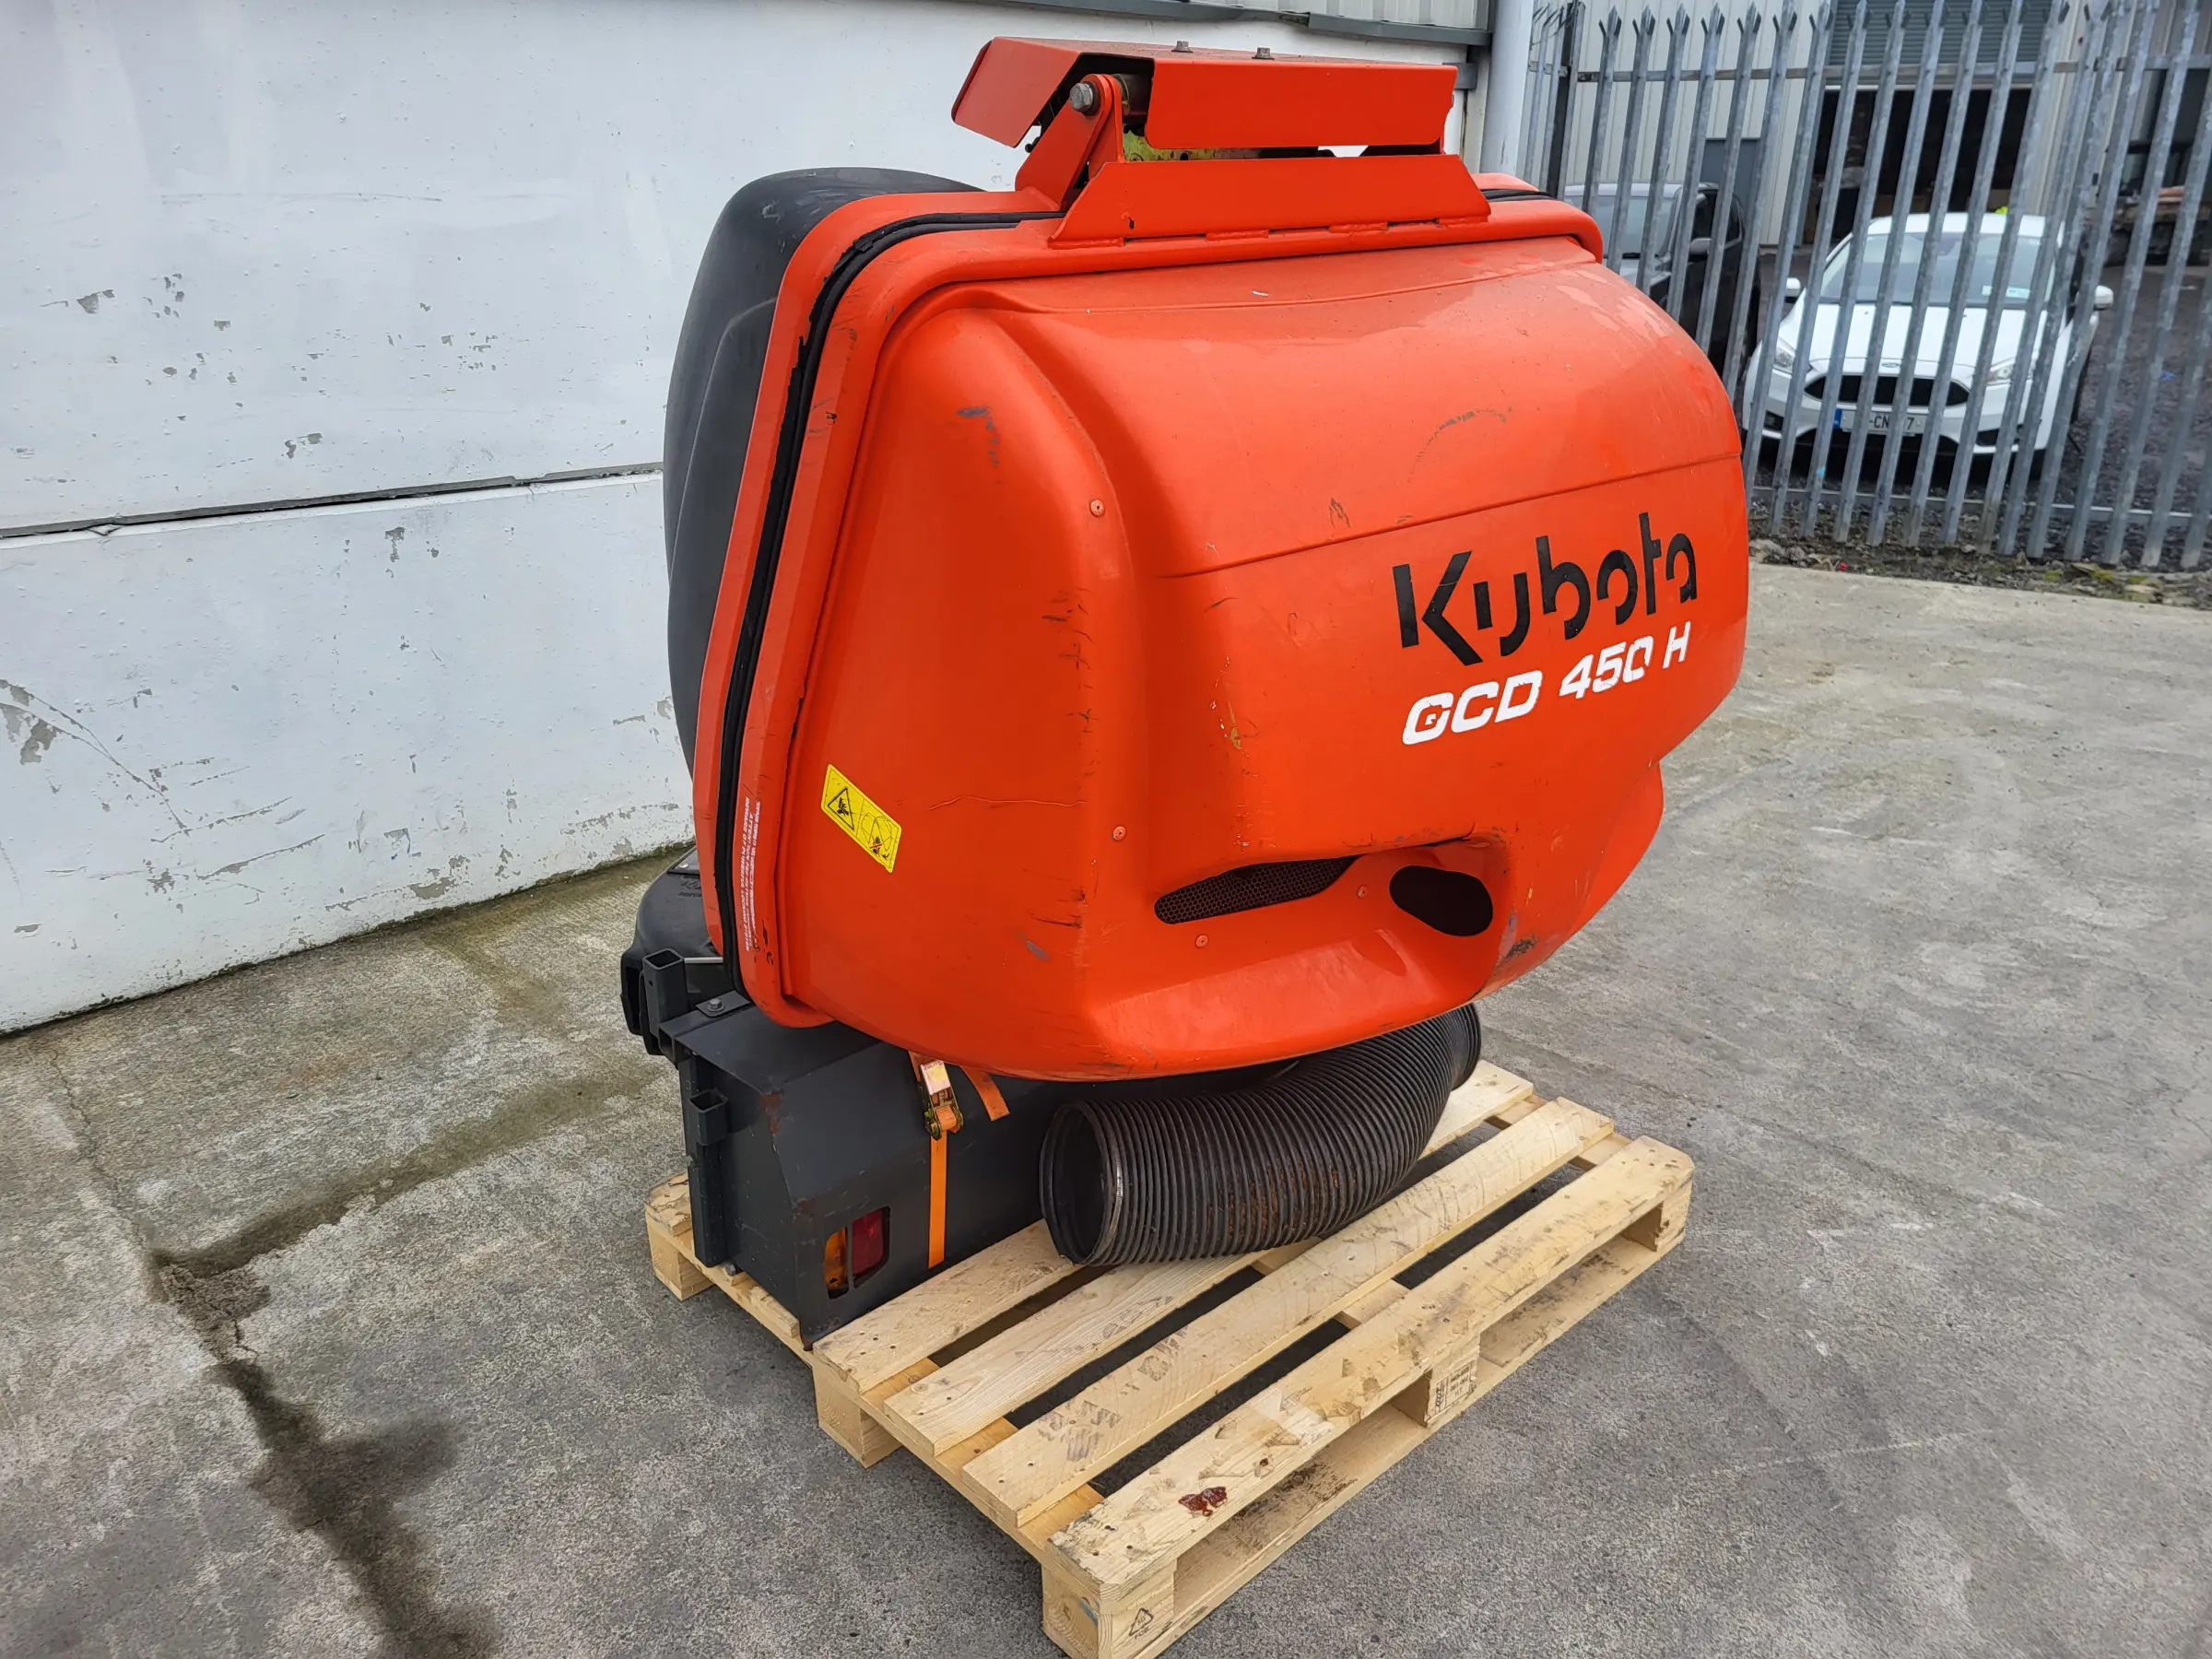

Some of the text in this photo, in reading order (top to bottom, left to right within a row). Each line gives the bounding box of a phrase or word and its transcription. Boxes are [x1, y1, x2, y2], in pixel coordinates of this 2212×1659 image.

[1392, 512, 1698, 665] Kubota
[1402, 620, 1691, 745] GCD 450 H
